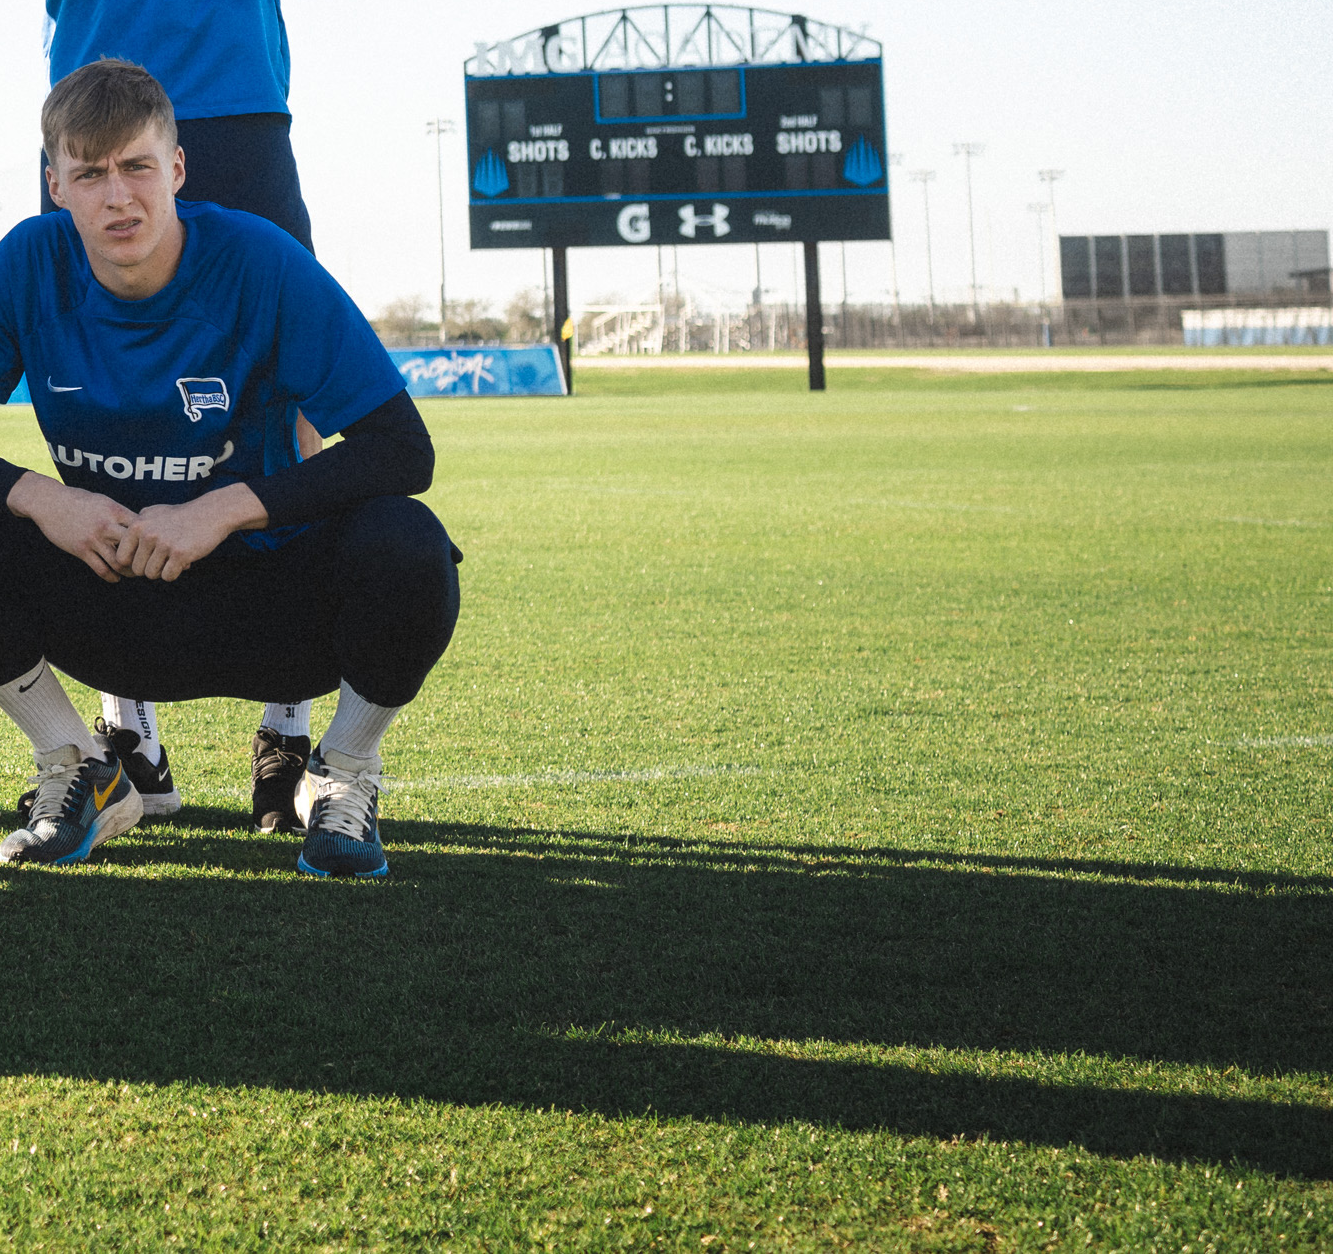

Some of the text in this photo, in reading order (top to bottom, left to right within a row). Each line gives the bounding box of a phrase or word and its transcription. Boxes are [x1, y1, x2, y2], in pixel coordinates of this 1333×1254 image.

[474, 33, 577, 76] IMG
[507, 140, 570, 163] SHOTS
[609, 136, 658, 159] KICKS
[704, 133, 754, 156] KICKS
[776, 130, 842, 154] SHOTS
[616, 203, 651, 243] G
[286, 707, 295, 718] 31
